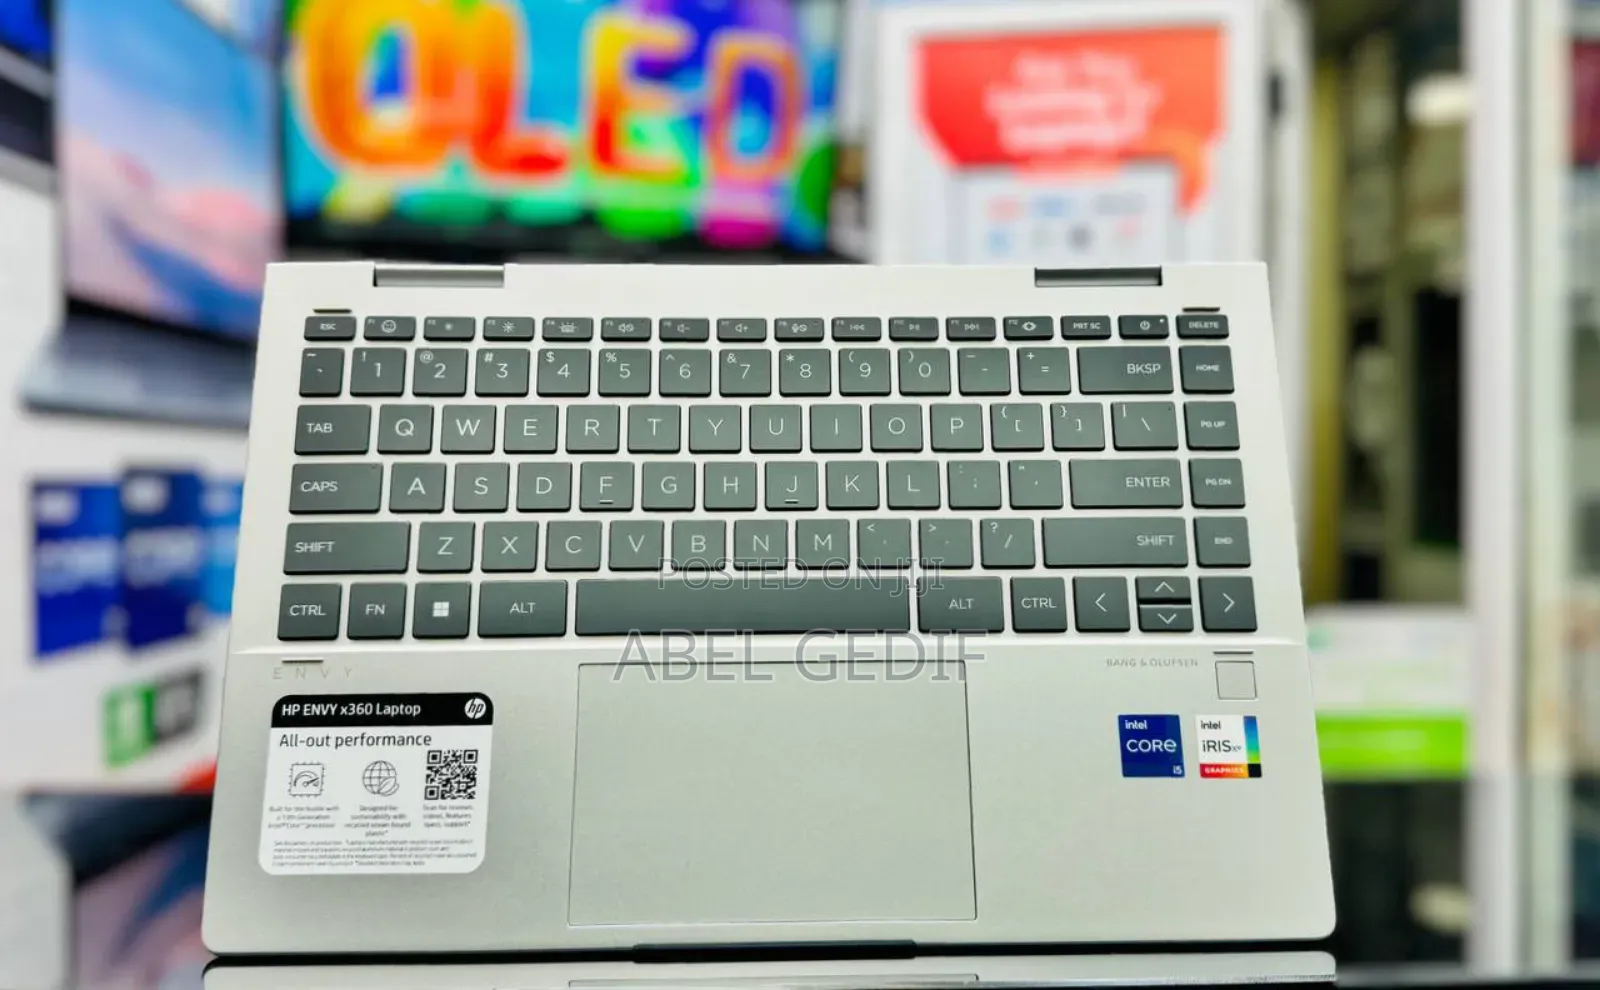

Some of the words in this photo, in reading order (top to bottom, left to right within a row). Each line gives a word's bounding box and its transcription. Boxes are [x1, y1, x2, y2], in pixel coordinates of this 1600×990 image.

[292, 0, 806, 183] OLED
[319, 322, 337, 331] ESC
[1072, 321, 1088, 330] PRT
[1089, 321, 1101, 330] SC
[1188, 320, 1220, 330] DELETE
[373, 362, 382, 379] 1
[433, 362, 447, 379] 2
[496, 362, 509, 379] 3
[556, 362, 572, 379] 4
[619, 363, 631, 380] 5
[679, 362, 692, 380] 6
[739, 363, 751, 380] 7
[799, 363, 813, 379] 8
[859, 361, 872, 379] 9
[1126, 362, 1162, 375] BKSP
[1195, 363, 1221, 373] HOME
[305, 421, 334, 434] TAB
[394, 418, 415, 438] Q
[455, 418, 481, 437] W
[522, 418, 538, 437] E
[584, 418, 600, 437] R
[647, 417, 663, 437] T
[707, 418, 724, 437] Y
[768, 417, 784, 436] U
[887, 416, 906, 435] O
[950, 416, 965, 435] P
[1200, 419, 1212, 429] PG
[1214, 419, 1226, 429] UP
[300, 480, 339, 493] CAPS
[406, 476, 427, 496] A
[473, 476, 489, 496] S
[535, 476, 554, 495] D
[599, 475, 614, 495] F
[660, 475, 678, 495] G
[722, 475, 739, 495] H
[785, 475, 798, 494] J
[844, 474, 861, 493] K
[907, 474, 921, 493] L
[1125, 476, 1171, 488] ENTER
[294, 540, 336, 554] SHIFT
[436, 535, 455, 556] Z
[500, 535, 519, 555] X
[564, 535, 583, 555] C
[627, 534, 645, 554] V
[690, 534, 707, 554] B
[752, 534, 770, 553] N
[813, 533, 833, 552] M
[1136, 534, 1175, 547] SHIFT
[1213, 536, 1234, 545] END
[288, 603, 327, 617] CTRL
[364, 602, 386, 616] FN
[509, 601, 537, 615] ALT
[948, 597, 975, 610] ALT
[1020, 596, 1058, 610] CTRL
[1106, 657, 1137, 667] BANG
[282, 704, 300, 716] HP
[302, 703, 338, 716] ENVY
[340, 703, 374, 715] x360
[376, 702, 421, 718] Laptop
[465, 699, 484, 718] hp
[1124, 719, 1148, 730] intel
[1200, 720, 1221, 730] intel
[279, 734, 331, 747] All-out
[335, 732, 432, 750] performance
[1172, 765, 1182, 775] i5
[1204, 766, 1245, 774] GRAPHICS
